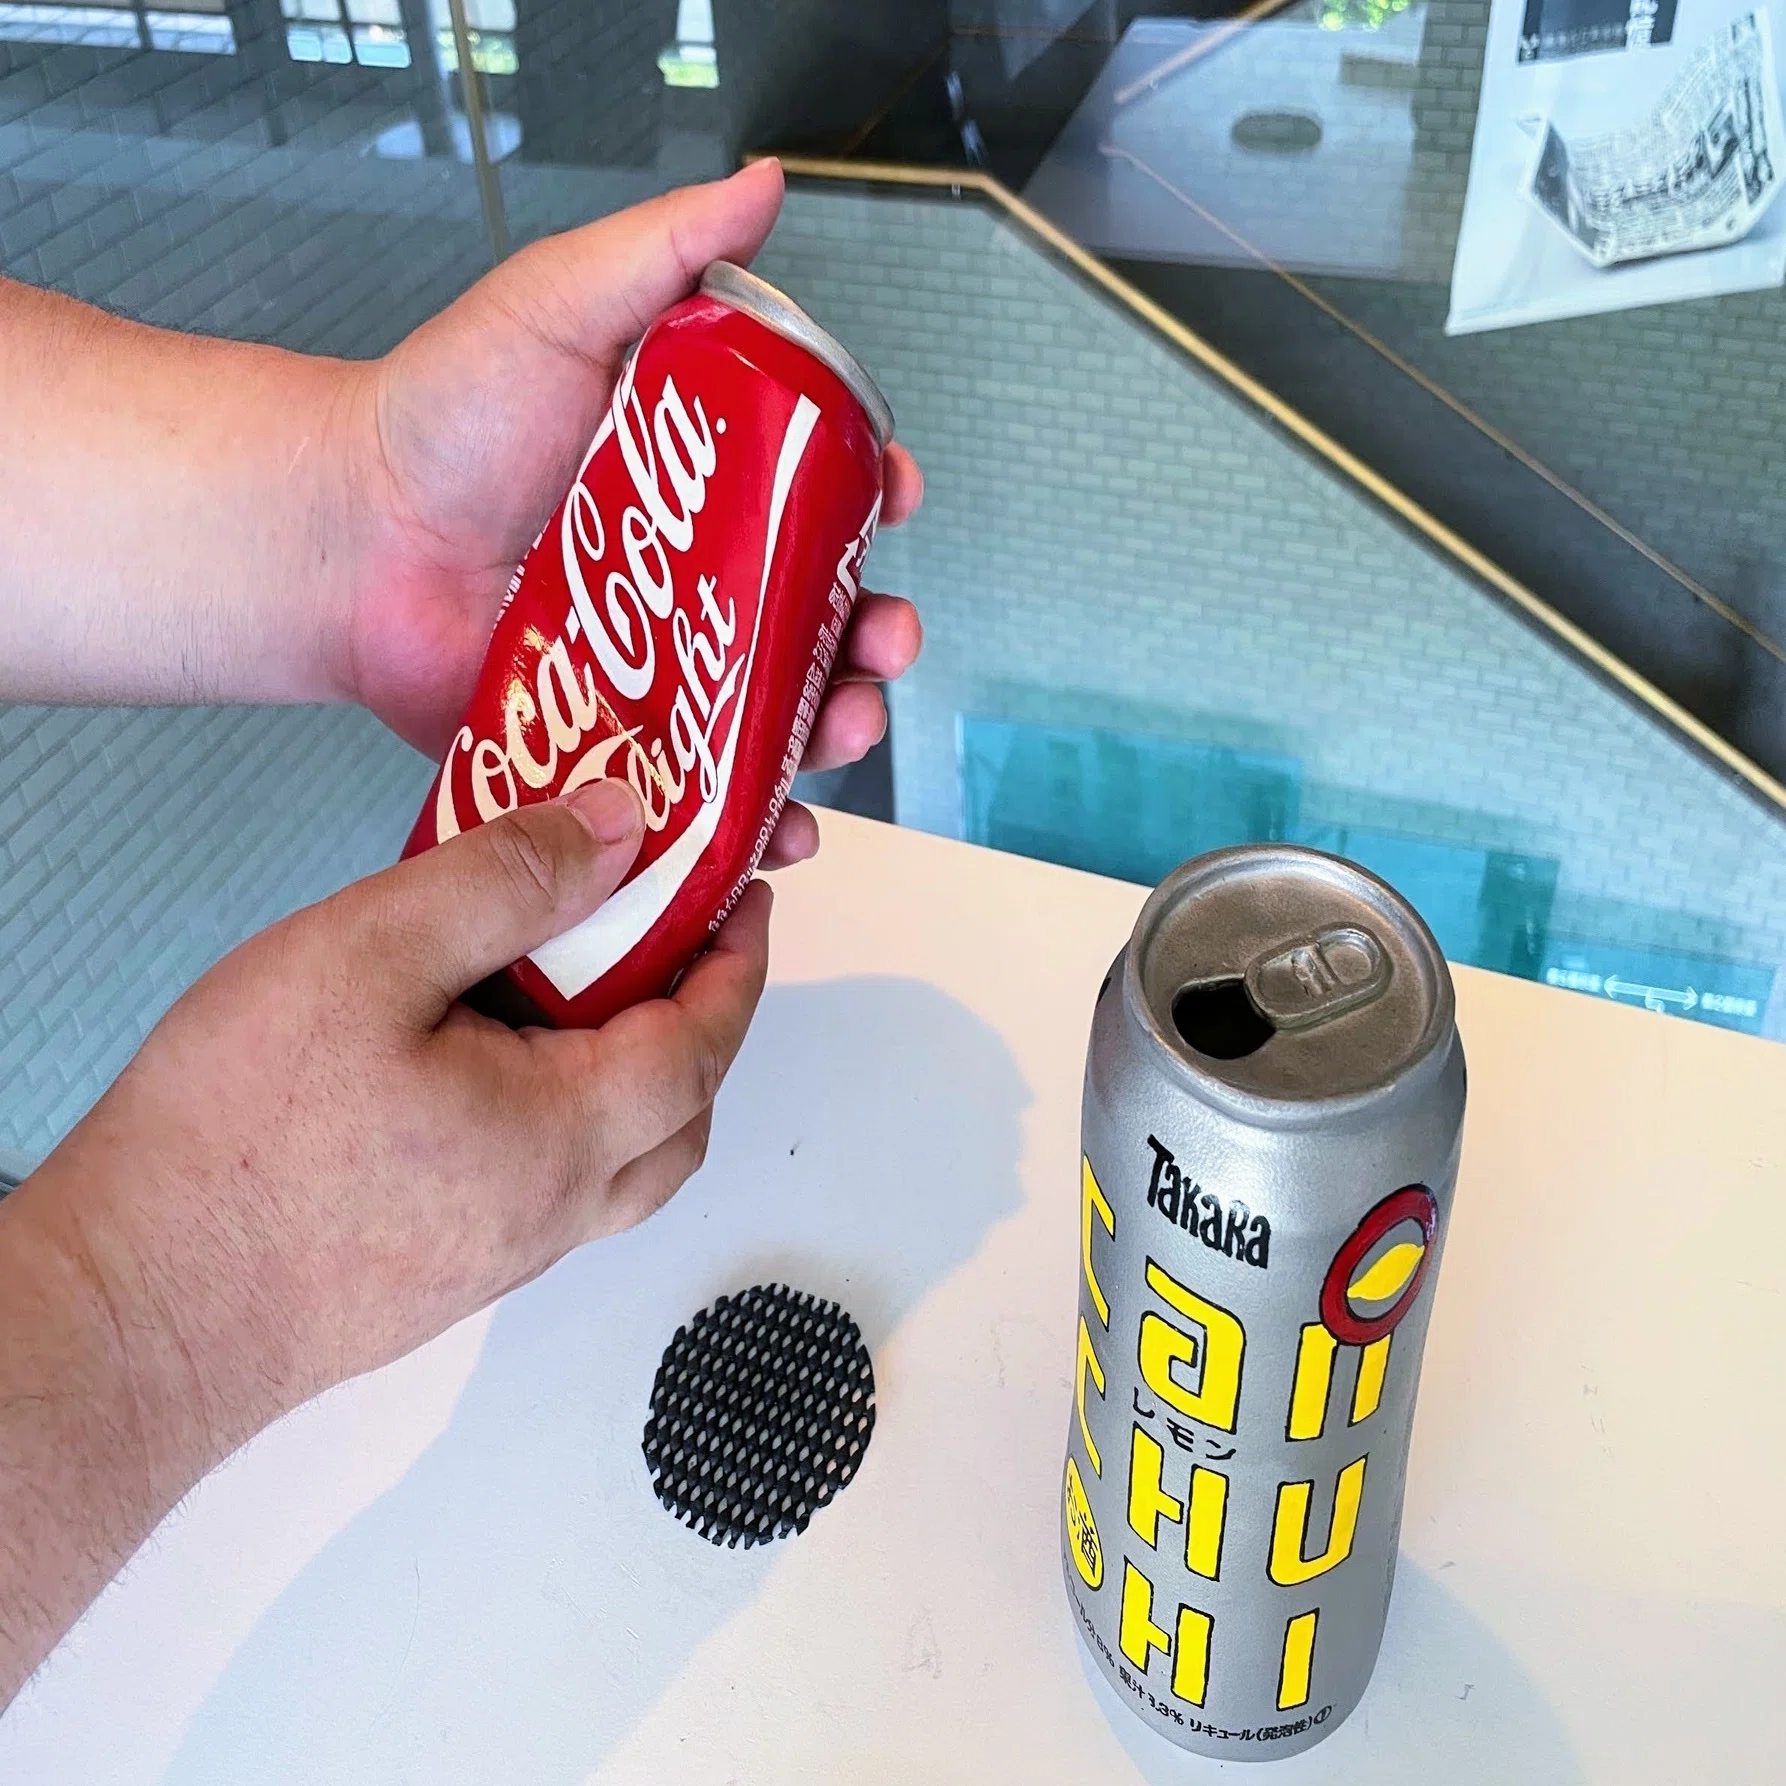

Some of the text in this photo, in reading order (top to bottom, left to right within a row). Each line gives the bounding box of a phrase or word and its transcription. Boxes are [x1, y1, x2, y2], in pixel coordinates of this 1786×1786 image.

[436, 359, 717, 846] Coca-Cola
[1131, 1386, 1238, 1461] レモン
